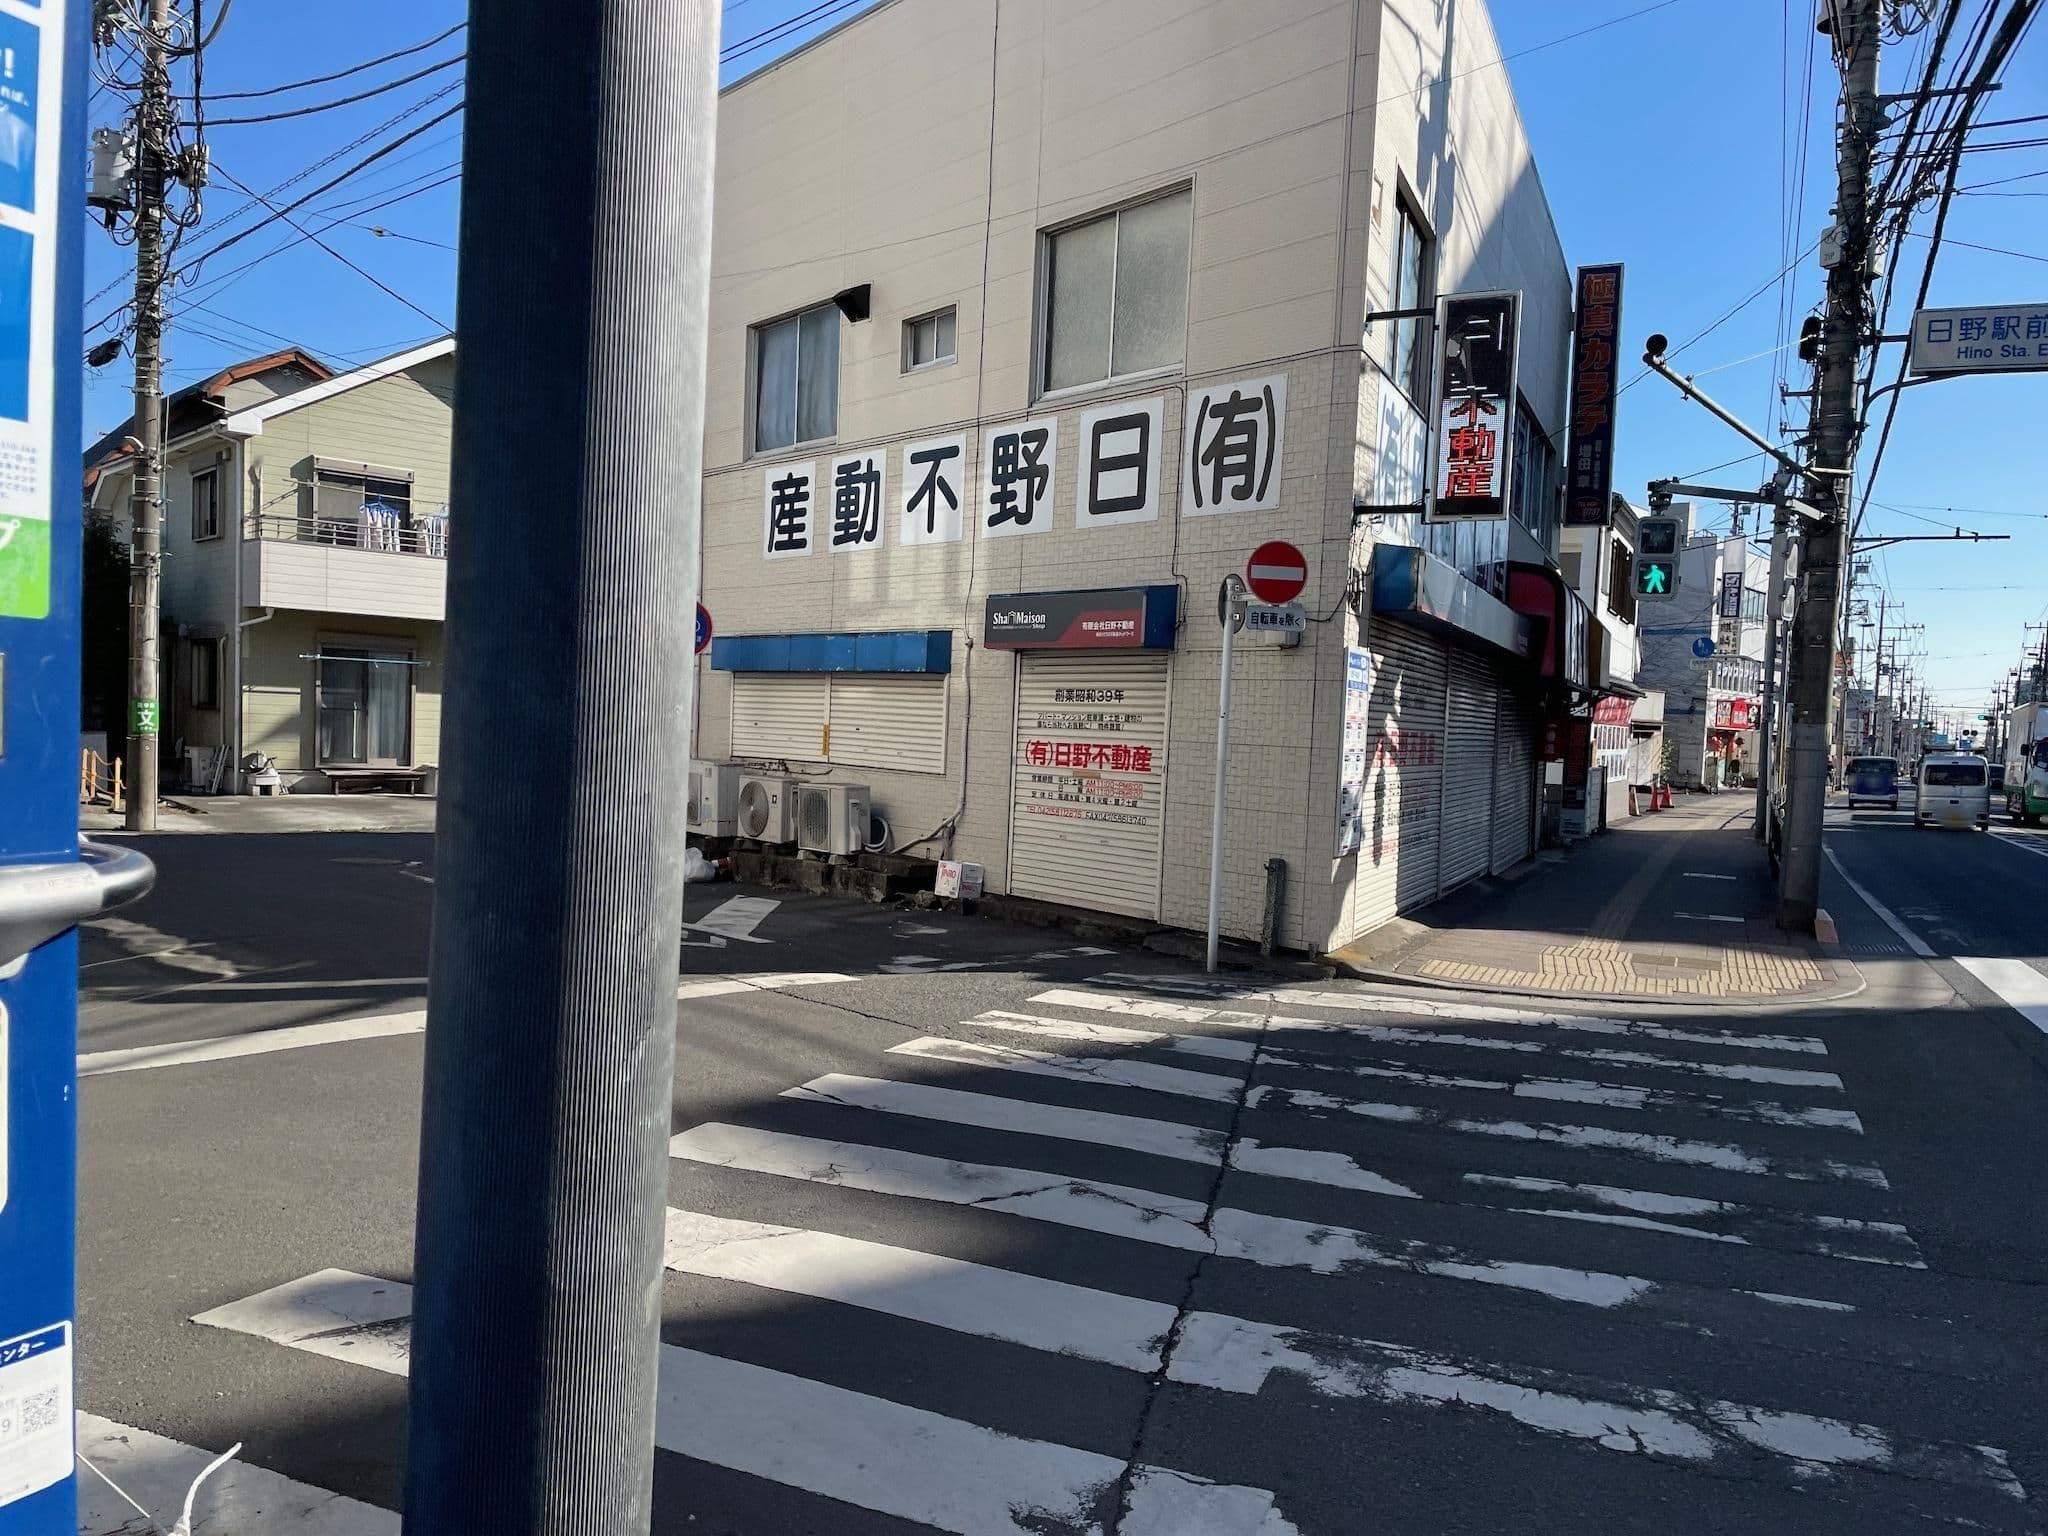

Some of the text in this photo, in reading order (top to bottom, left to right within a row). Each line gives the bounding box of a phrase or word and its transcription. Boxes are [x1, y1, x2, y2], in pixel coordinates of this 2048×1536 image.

[1927, 315, 2048, 343] 日野駅前
[1576, 273, 1616, 436] 極真カラテ
[1957, 346, 1993, 359] Hino
[2000, 345, 2030, 358] Sta.
[1251, 611, 1301, 630] 自転車を除く
[1055, 687, 1125, 703] 創業昭和39年
[137, 709, 155, 726] 文
[1025, 738, 1153, 773] (有)日野不動産
[0, 1342, 46, 1364] ンター
